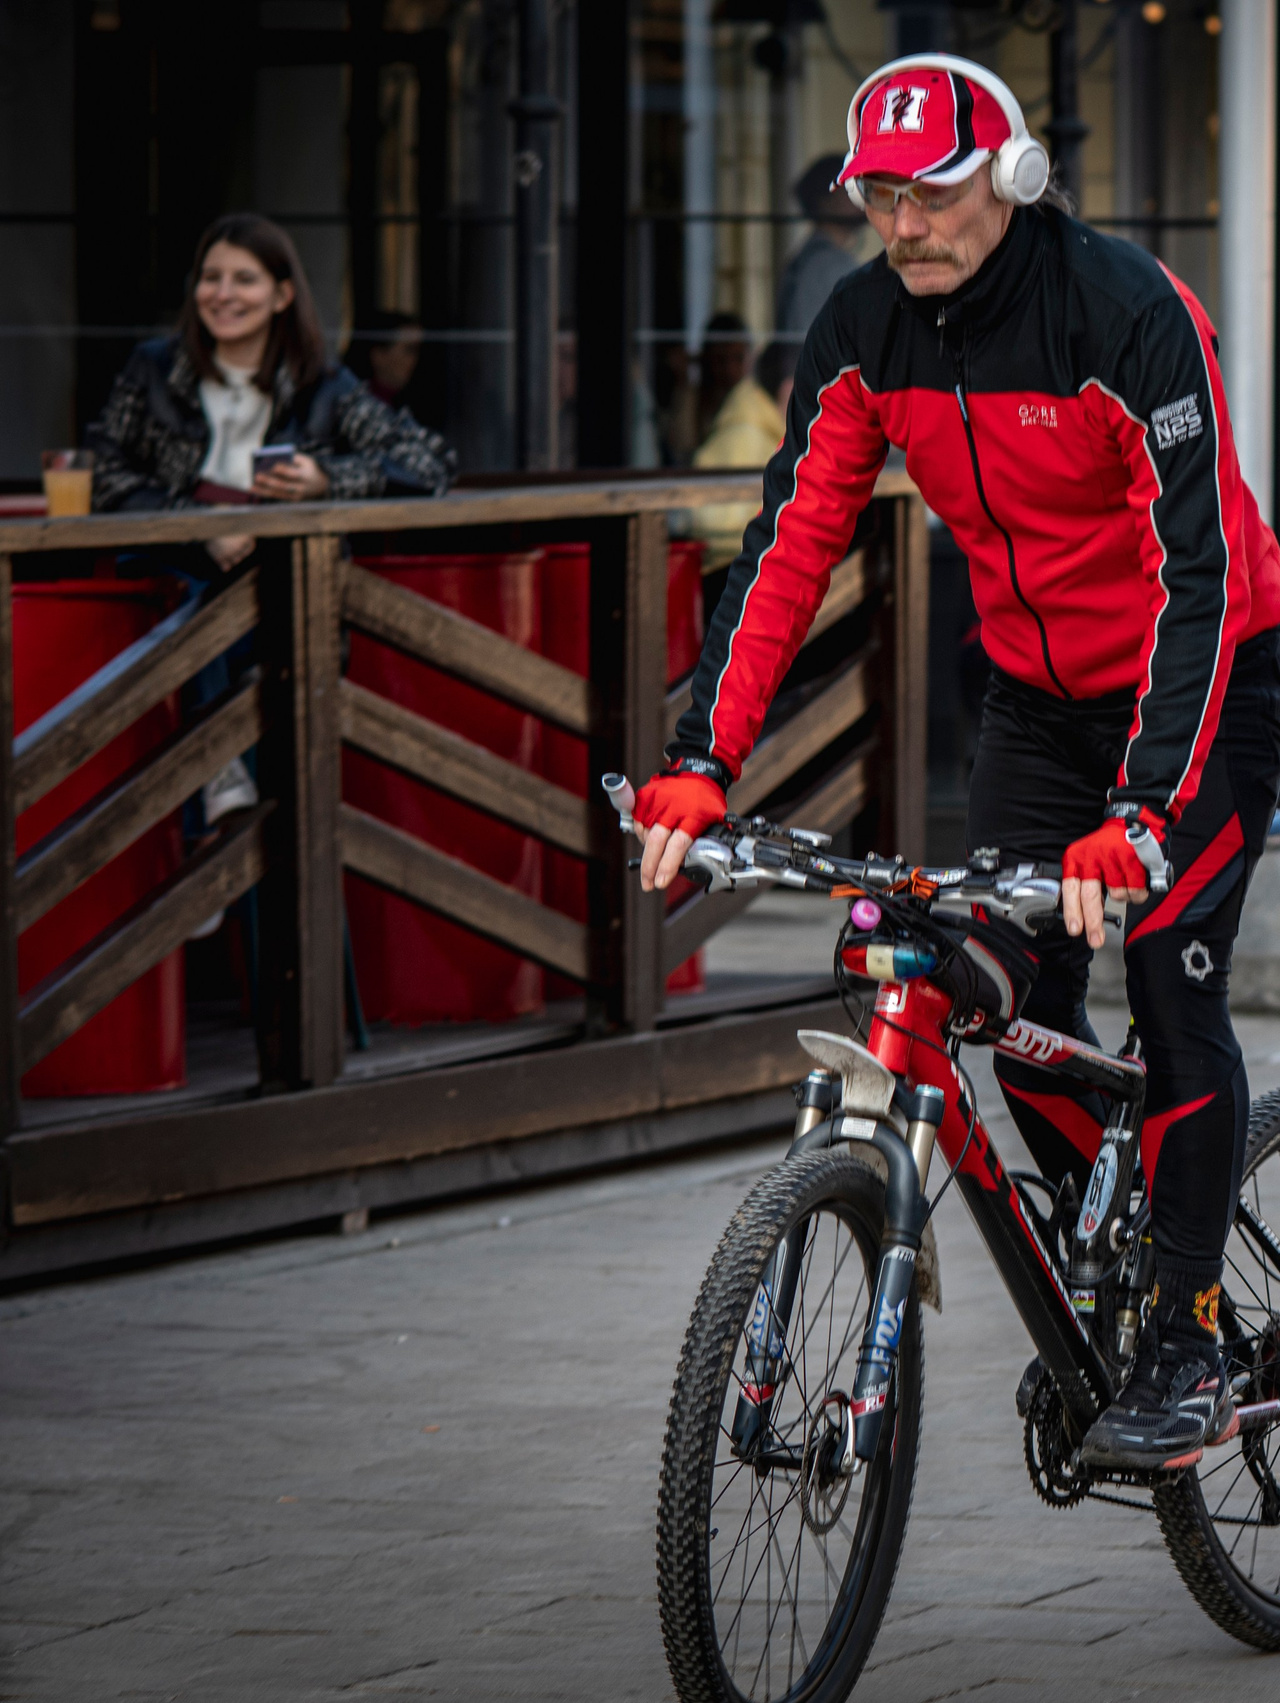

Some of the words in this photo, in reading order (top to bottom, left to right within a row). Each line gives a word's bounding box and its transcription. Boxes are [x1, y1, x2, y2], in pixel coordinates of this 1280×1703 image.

[1018, 404, 1058, 420] GORE
[870, 1295, 905, 1375] FOX
[865, 1396, 883, 1412] RL
